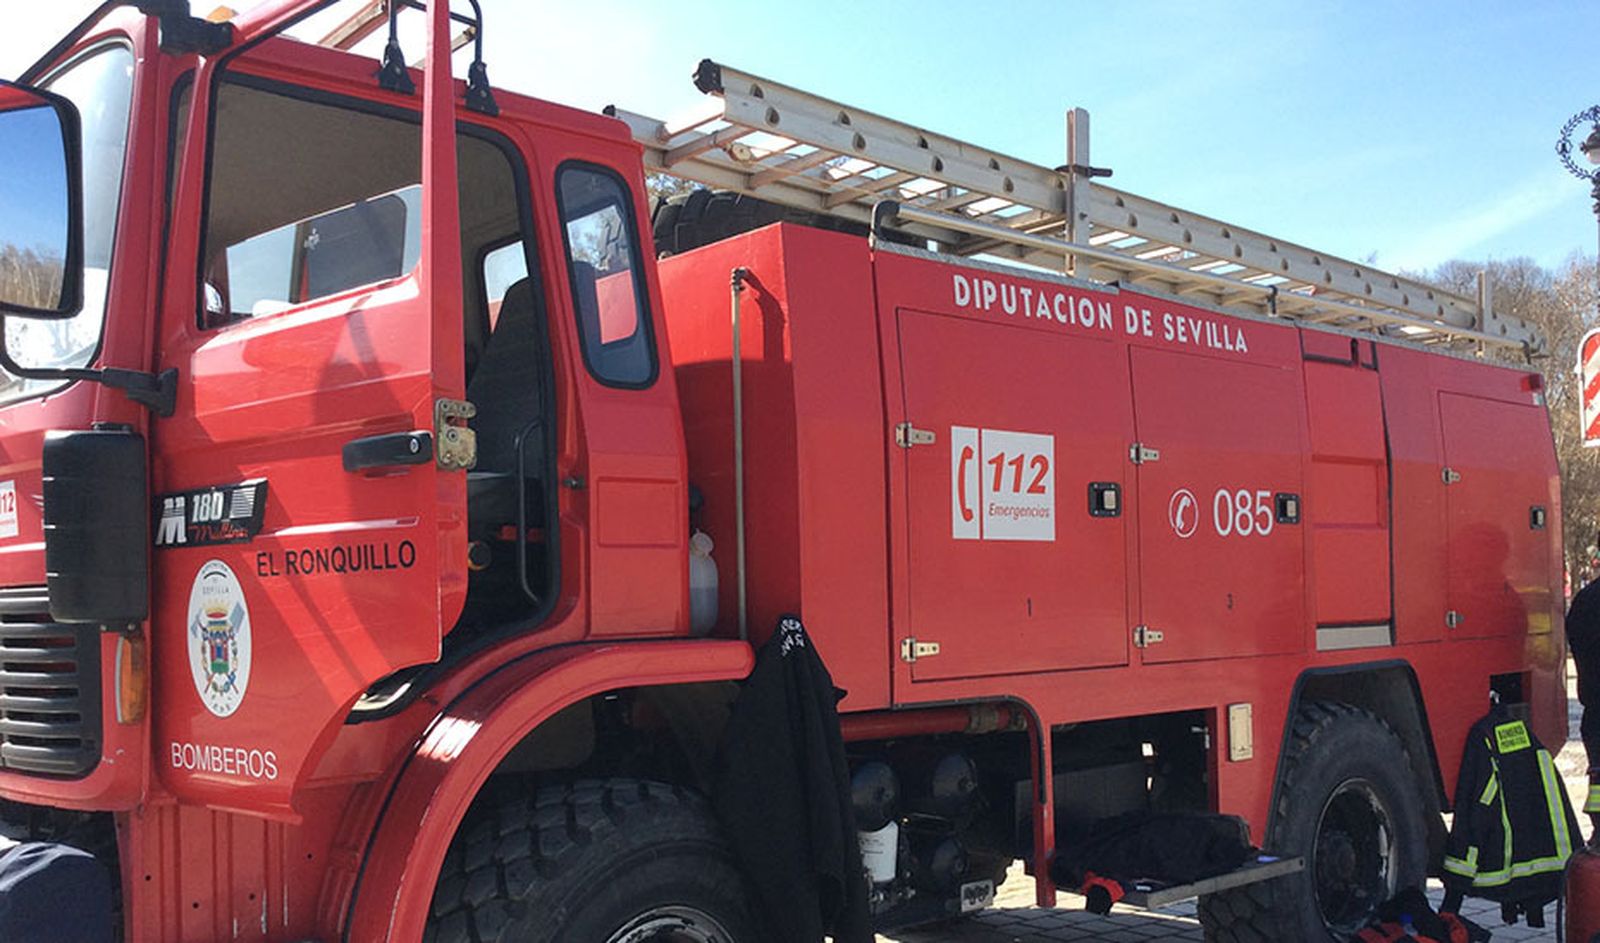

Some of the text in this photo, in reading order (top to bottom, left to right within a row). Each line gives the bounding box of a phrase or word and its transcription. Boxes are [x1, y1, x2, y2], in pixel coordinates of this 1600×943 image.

[953, 274, 1249, 353] DIPUTACION DE SEVILLA
[988, 451, 1050, 494] 112
[0, 491, 15, 514] 12
[155, 492, 225, 545] M 180
[988, 502, 1050, 520] Emergencias
[1213, 488, 1274, 536] 085
[256, 540, 417, 577] EL RONQUILLO
[171, 742, 278, 780] BOMBEROS
